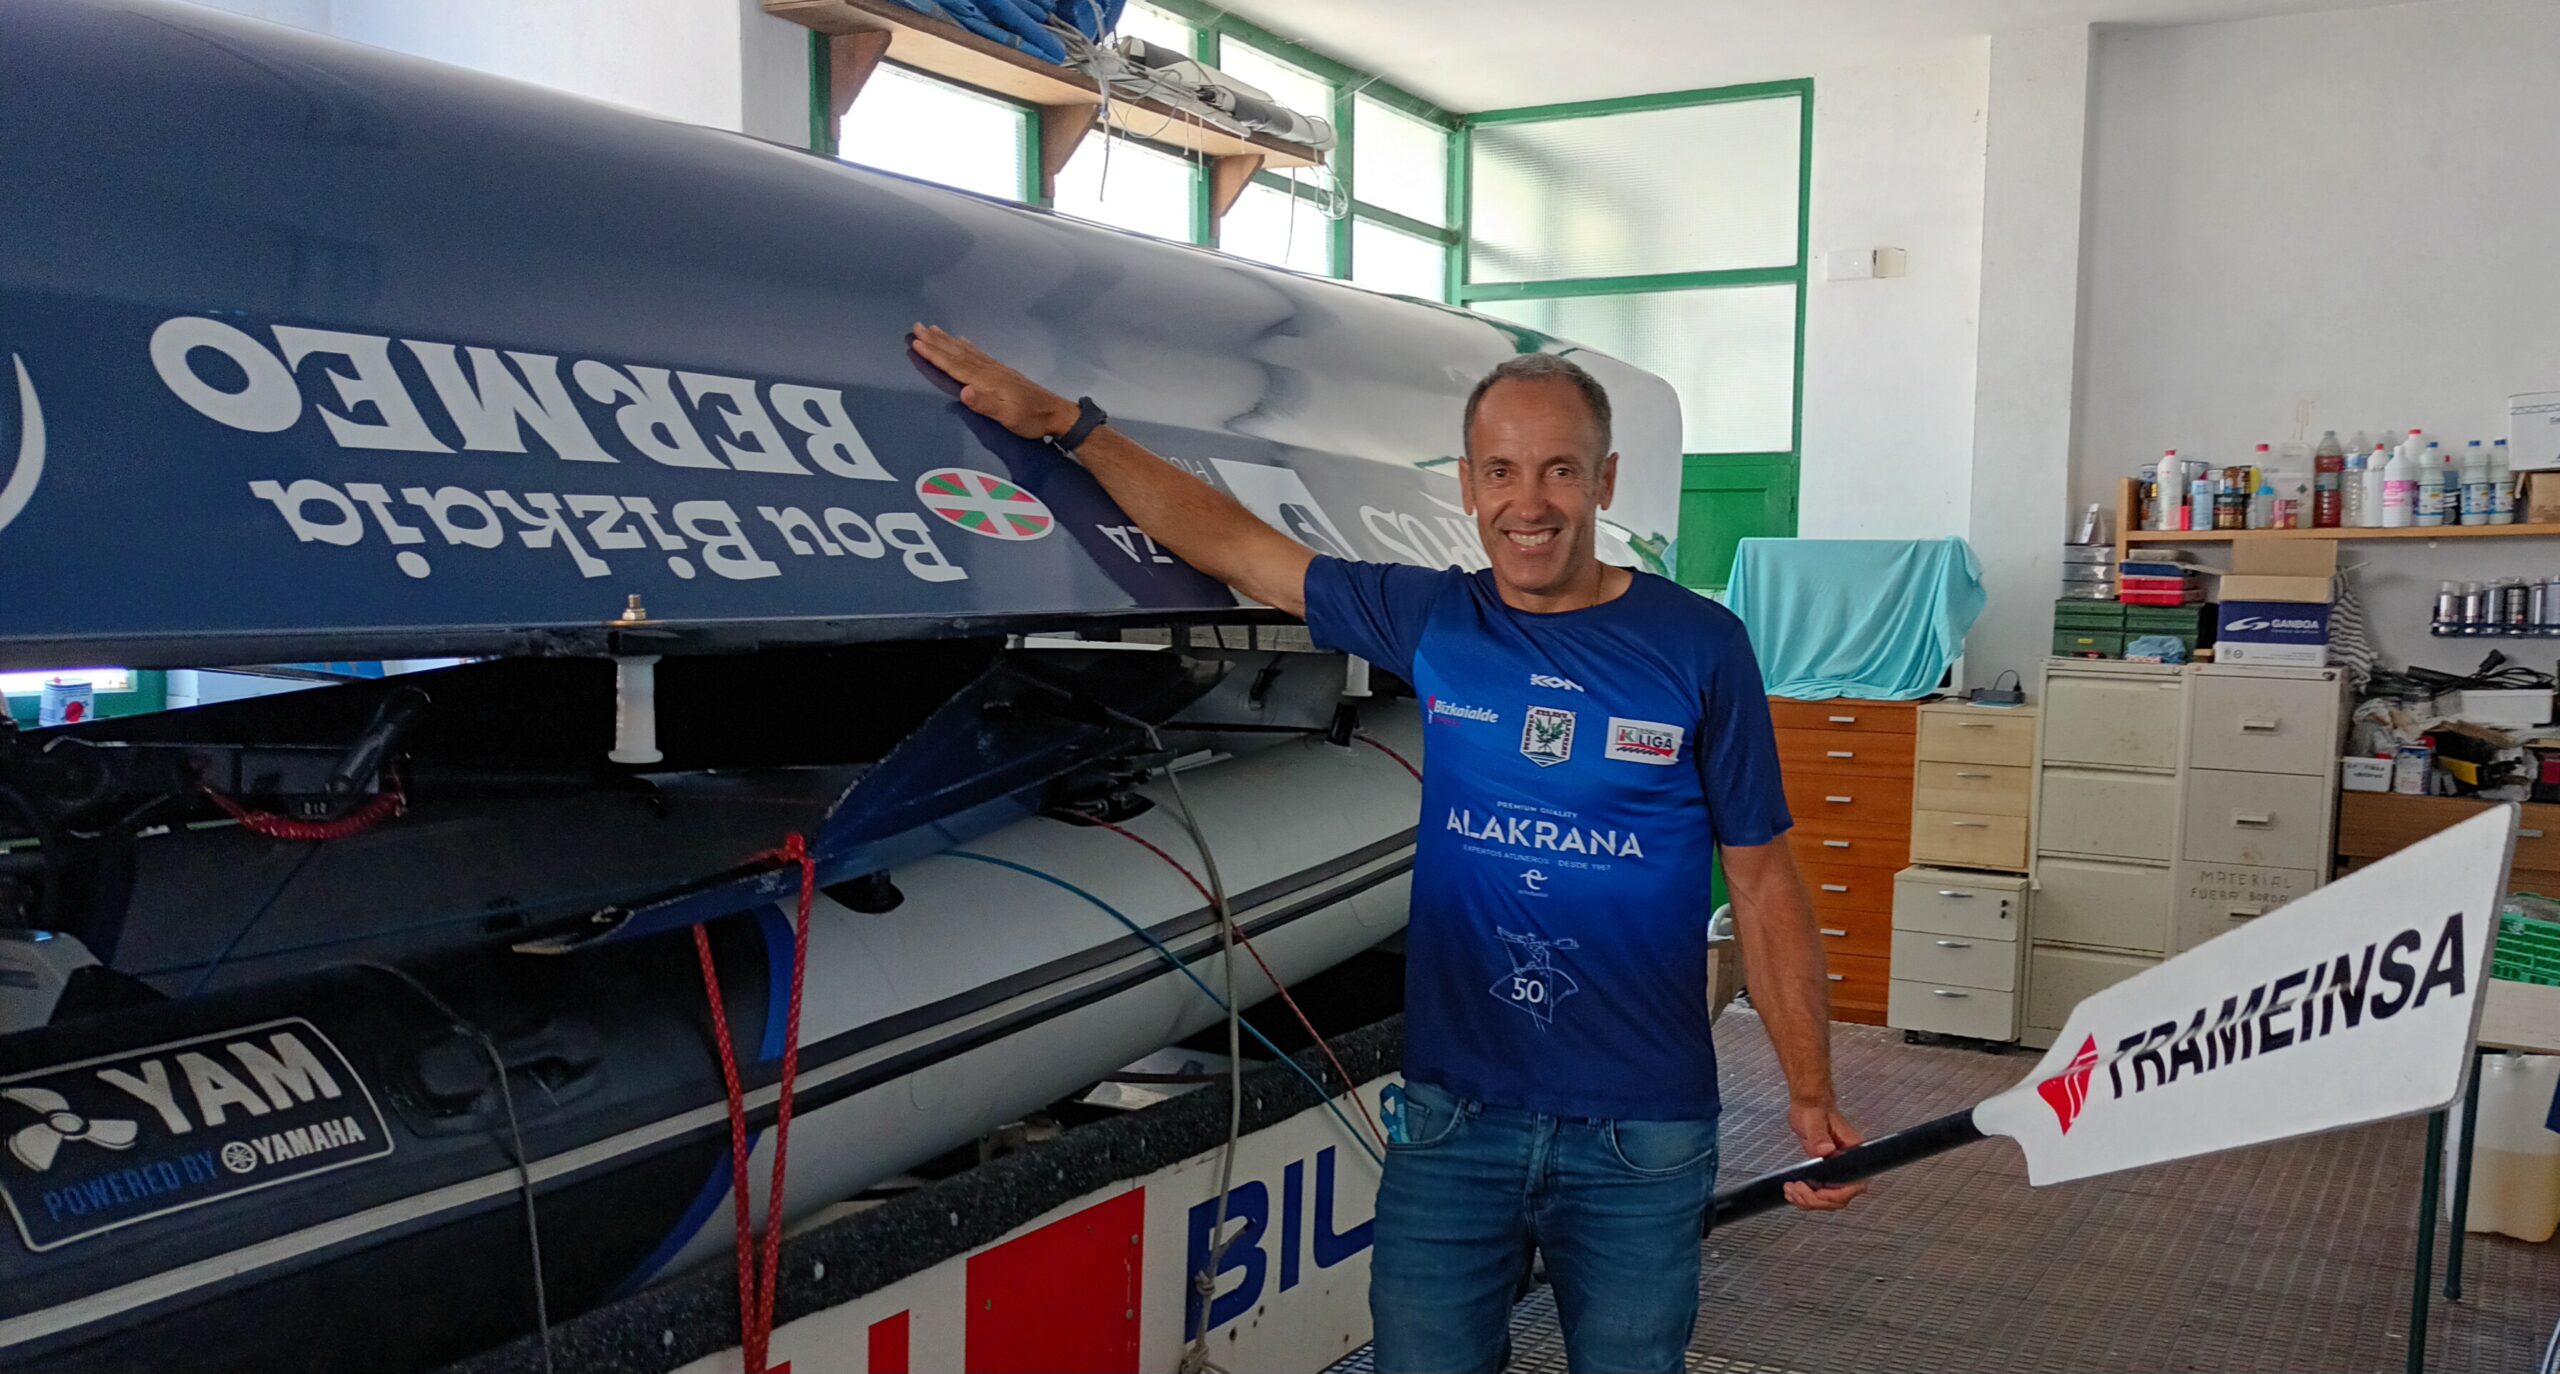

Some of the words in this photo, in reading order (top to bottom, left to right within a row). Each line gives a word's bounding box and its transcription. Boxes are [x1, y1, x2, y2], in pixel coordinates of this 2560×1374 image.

[149, 316, 899, 482] BERMEO
[249, 477, 782, 580] Bizkaia
[757, 503, 969, 582] Bou
[1434, 700, 1499, 723] Bizkaialde
[1638, 733, 1673, 749] LIGA
[1446, 806, 1644, 858] ALAKRANA
[1497, 801, 1537, 812] PREMIUM
[1540, 807, 1578, 819] QUALITY
[1463, 843, 1502, 858] EXPERTOS
[1503, 852, 1550, 865] ATUNEROS
[1557, 859, 1588, 870] DESDE
[1511, 977, 1544, 1003] 50
[2108, 912, 2466, 1099] TRAMEINSA
[97, 1032, 343, 1135] YAM
[41, 1160, 182, 1222] POWERED
[185, 1151, 218, 1184] BY
[252, 1116, 366, 1164] YAMAHA
